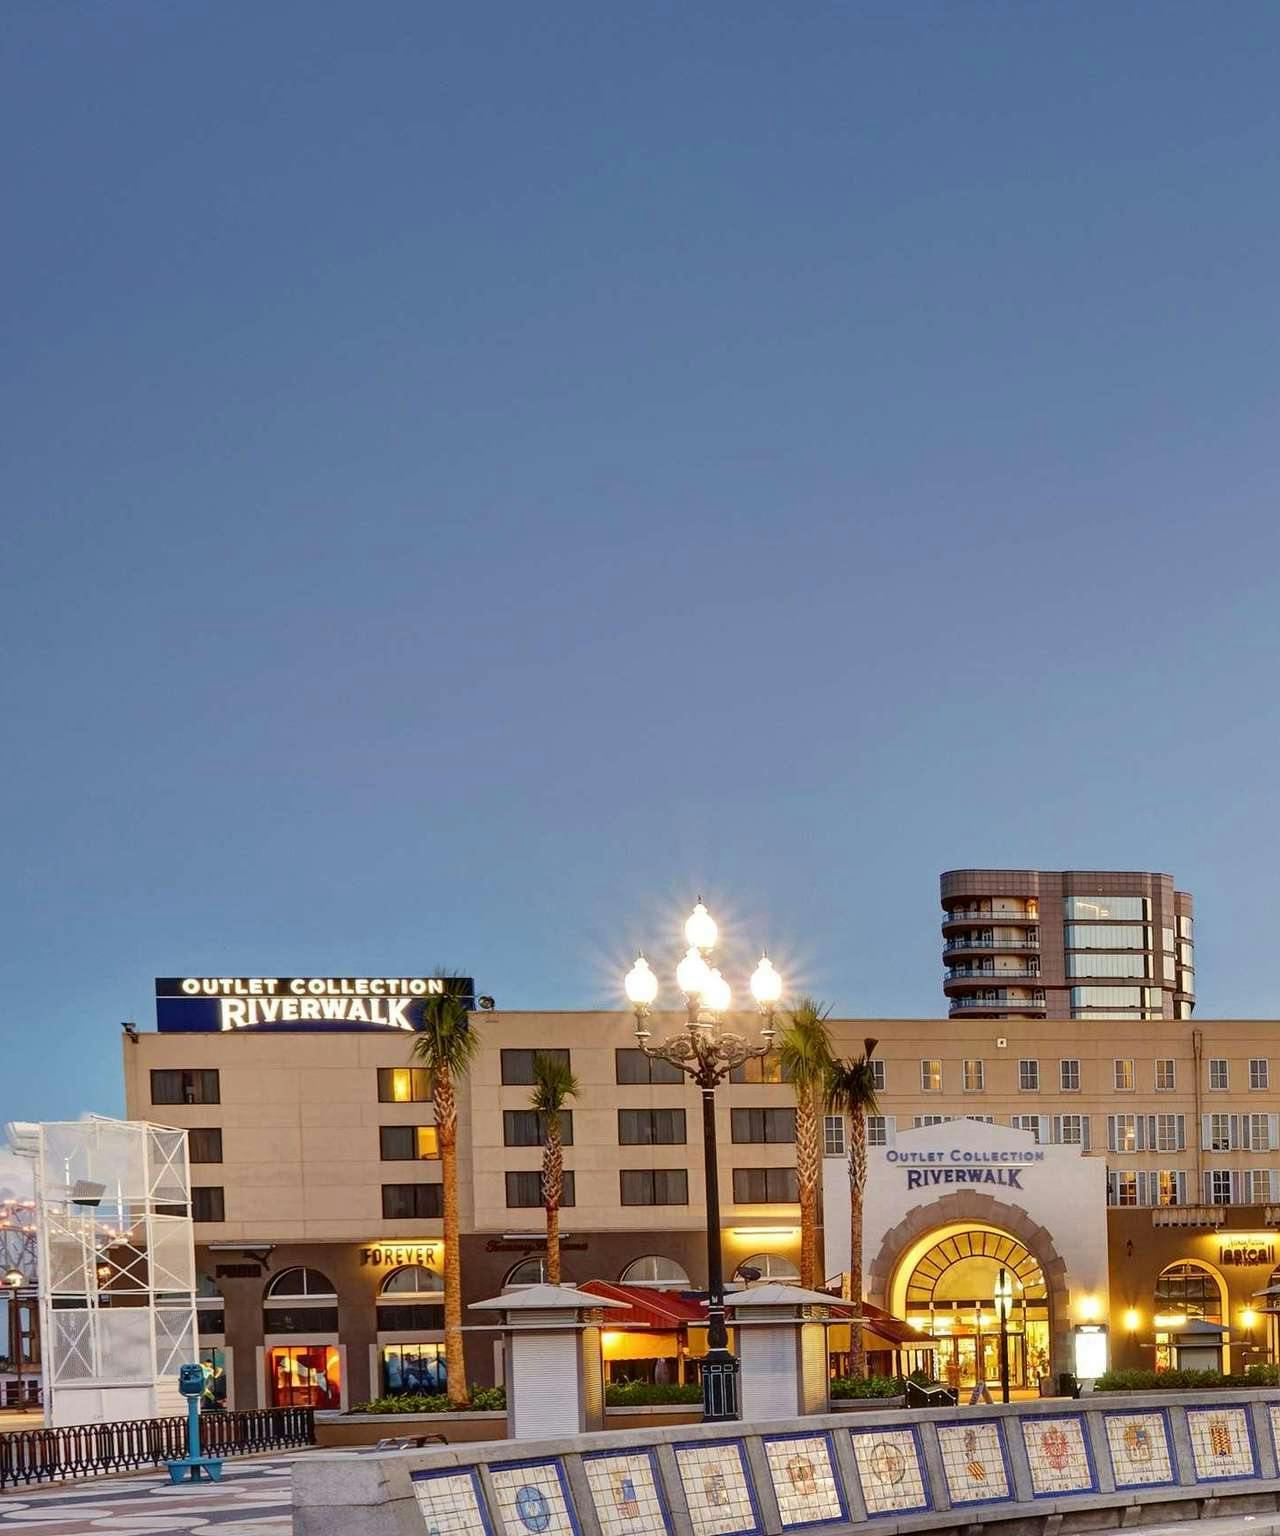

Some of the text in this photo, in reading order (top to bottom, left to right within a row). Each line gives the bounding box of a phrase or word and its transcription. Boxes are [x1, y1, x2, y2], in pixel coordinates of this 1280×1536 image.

[181, 978, 444, 995] OUTLET COLLECTION
[219, 998, 416, 1032] RIVERWALK
[886, 1150, 1045, 1163] OUTLET COLLECTION
[906, 1168, 1024, 1191] RIVERWALK
[360, 1248, 436, 1266] FOREVER
